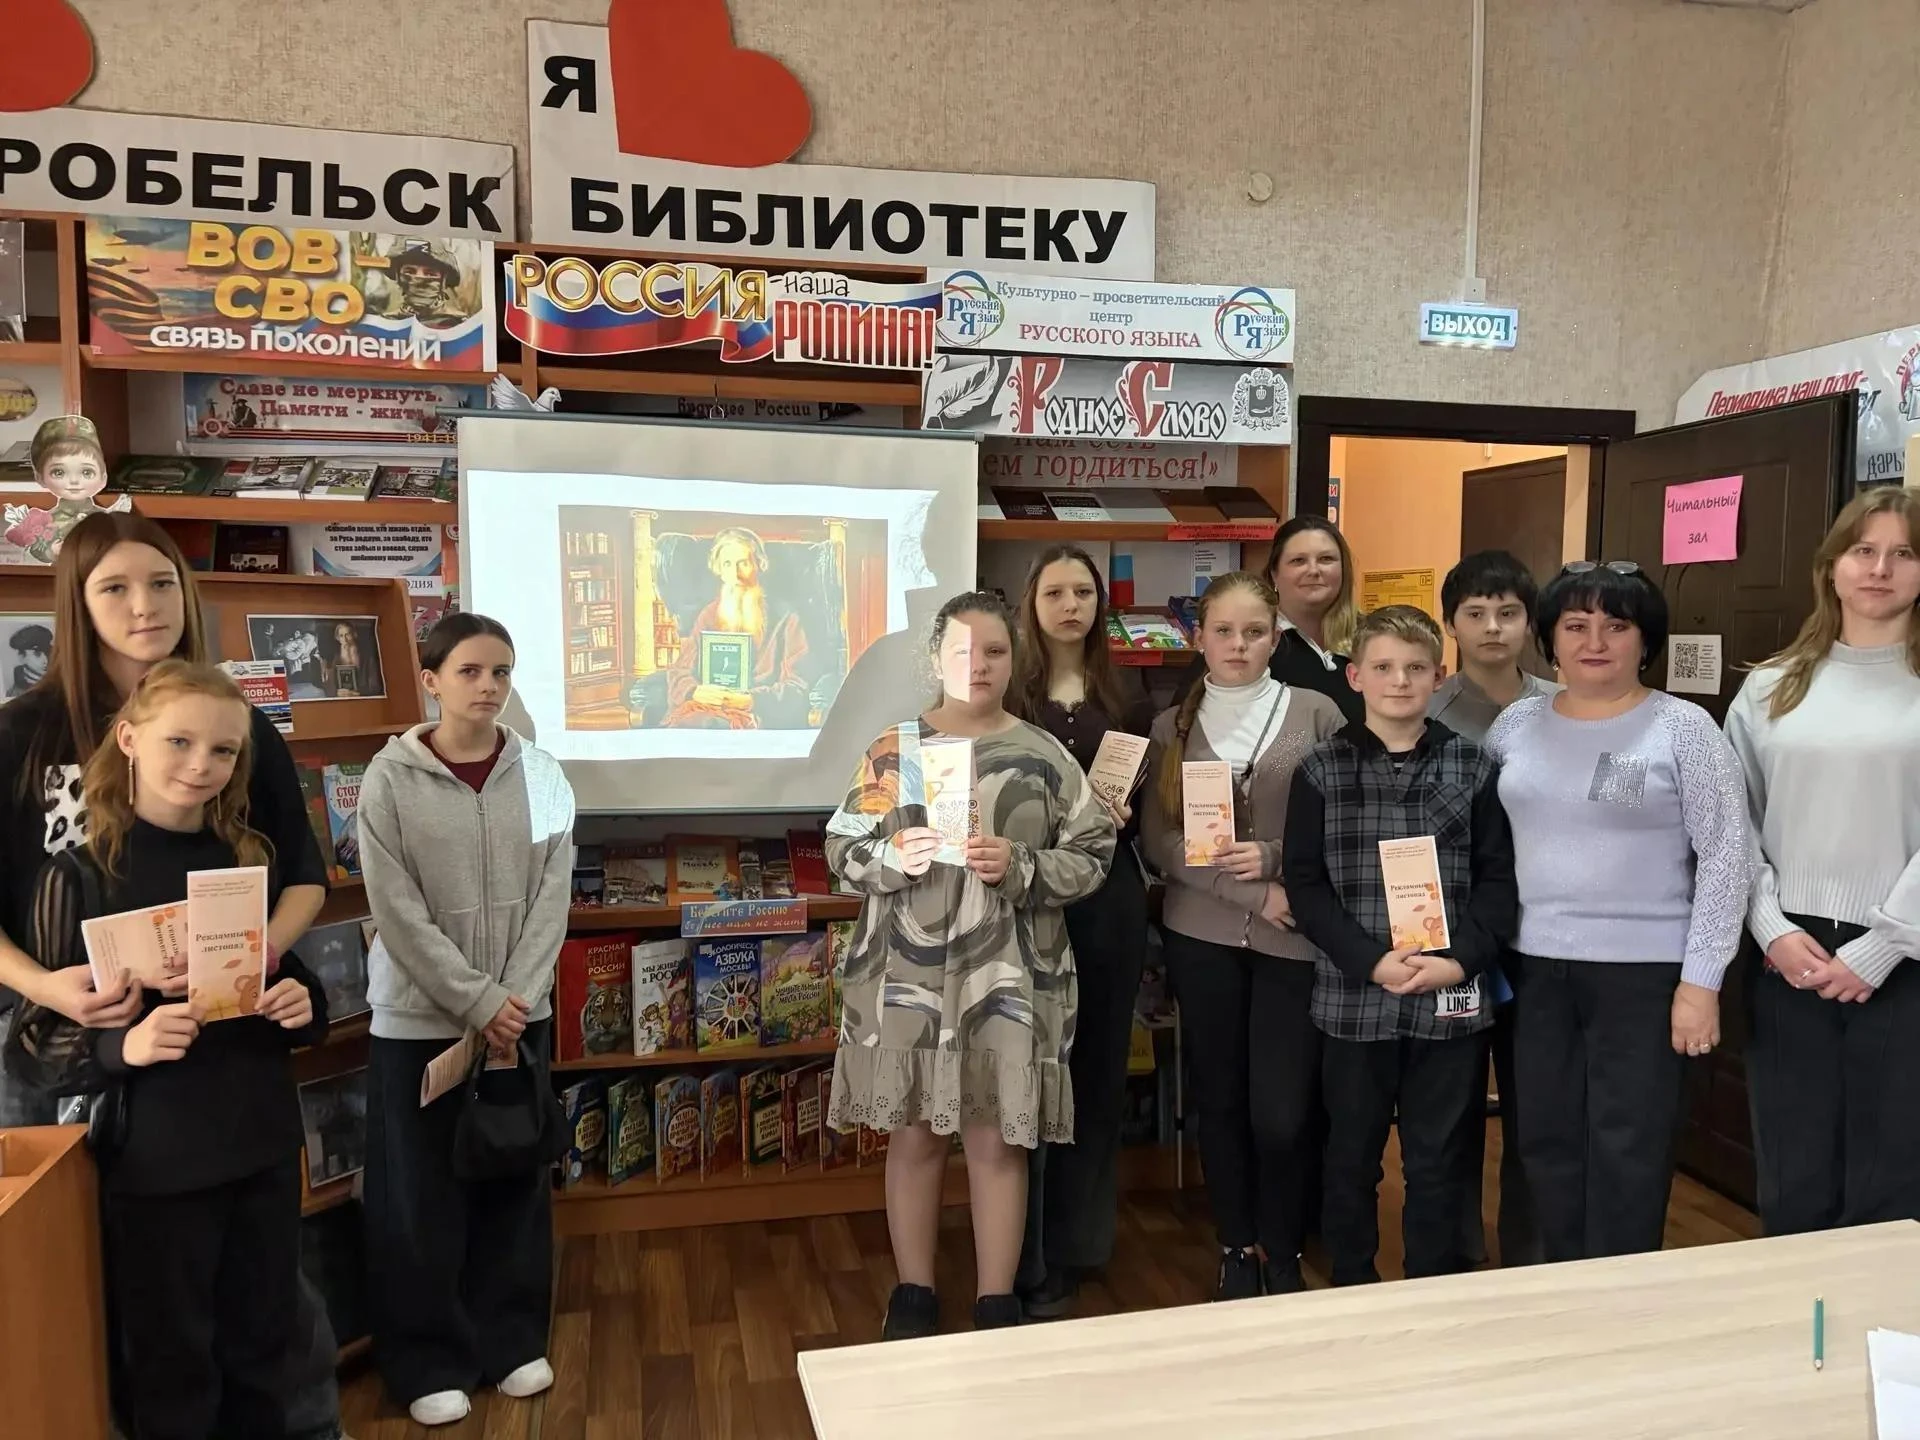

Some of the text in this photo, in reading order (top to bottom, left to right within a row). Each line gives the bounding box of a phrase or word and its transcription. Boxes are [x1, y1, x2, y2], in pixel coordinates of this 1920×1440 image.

[541, 55, 598, 113] Я
[0, 137, 502, 233] РОБЕЛЬСК
[570, 177, 1128, 263] БИБЛИОТЕКУ
[187, 222, 340, 274] ВОВ
[214, 275, 364, 326] СВО
[514, 255, 766, 321] РОССИЯ
[785, 272, 850, 297] наша
[996, 281, 1077, 301] Культурно
[1093, 293, 1226, 308] просветительский
[1089, 310, 1133, 326] центр
[1431, 313, 1509, 340] ВЫХОД
[774, 300, 935, 369] РОДИНА!
[1019, 324, 1202, 348] РУССКОГО ЯЗЫКА
[219, 377, 287, 397] Славе
[292, 384, 319, 398] не
[1704, 385, 1788, 418] Периодика
[1789, 379, 1823, 402] наш
[260, 400, 349, 418] Памяти
[370, 406, 427, 422] жить
[754, 398, 811, 418] России
[1034, 451, 1218, 485] гордиться!»
[1666, 490, 1738, 514] Читальный
[1688, 531, 1709, 545] зал
[588, 942, 625, 955] КРАСНАЯ
[715, 950, 756, 967] АЗБУКА
[588, 963, 625, 976] РОССИИ
[720, 963, 752, 974] МОСКВЫ
